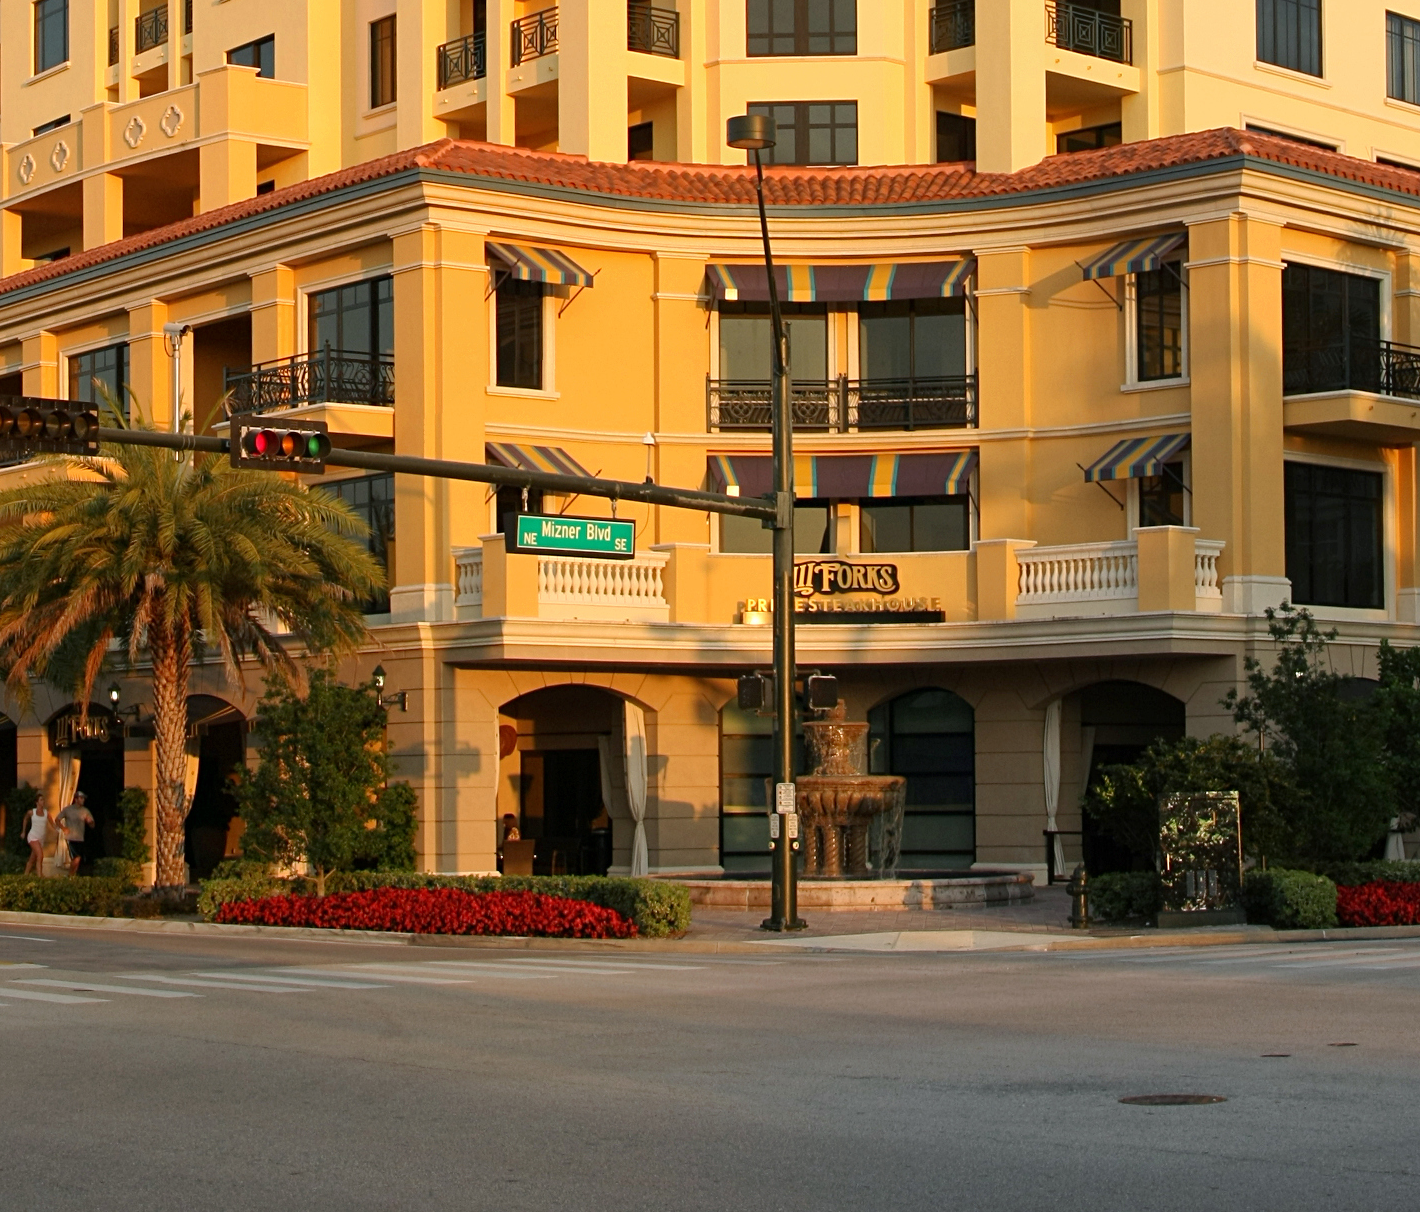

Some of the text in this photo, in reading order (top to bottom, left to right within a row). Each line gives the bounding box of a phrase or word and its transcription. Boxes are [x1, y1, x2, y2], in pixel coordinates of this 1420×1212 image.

[523, 520, 627, 551] NE Mizner Blvd SE
[814, 562, 896, 592] FORKS
[747, 597, 942, 612] PRIE STEAKHOUSE
